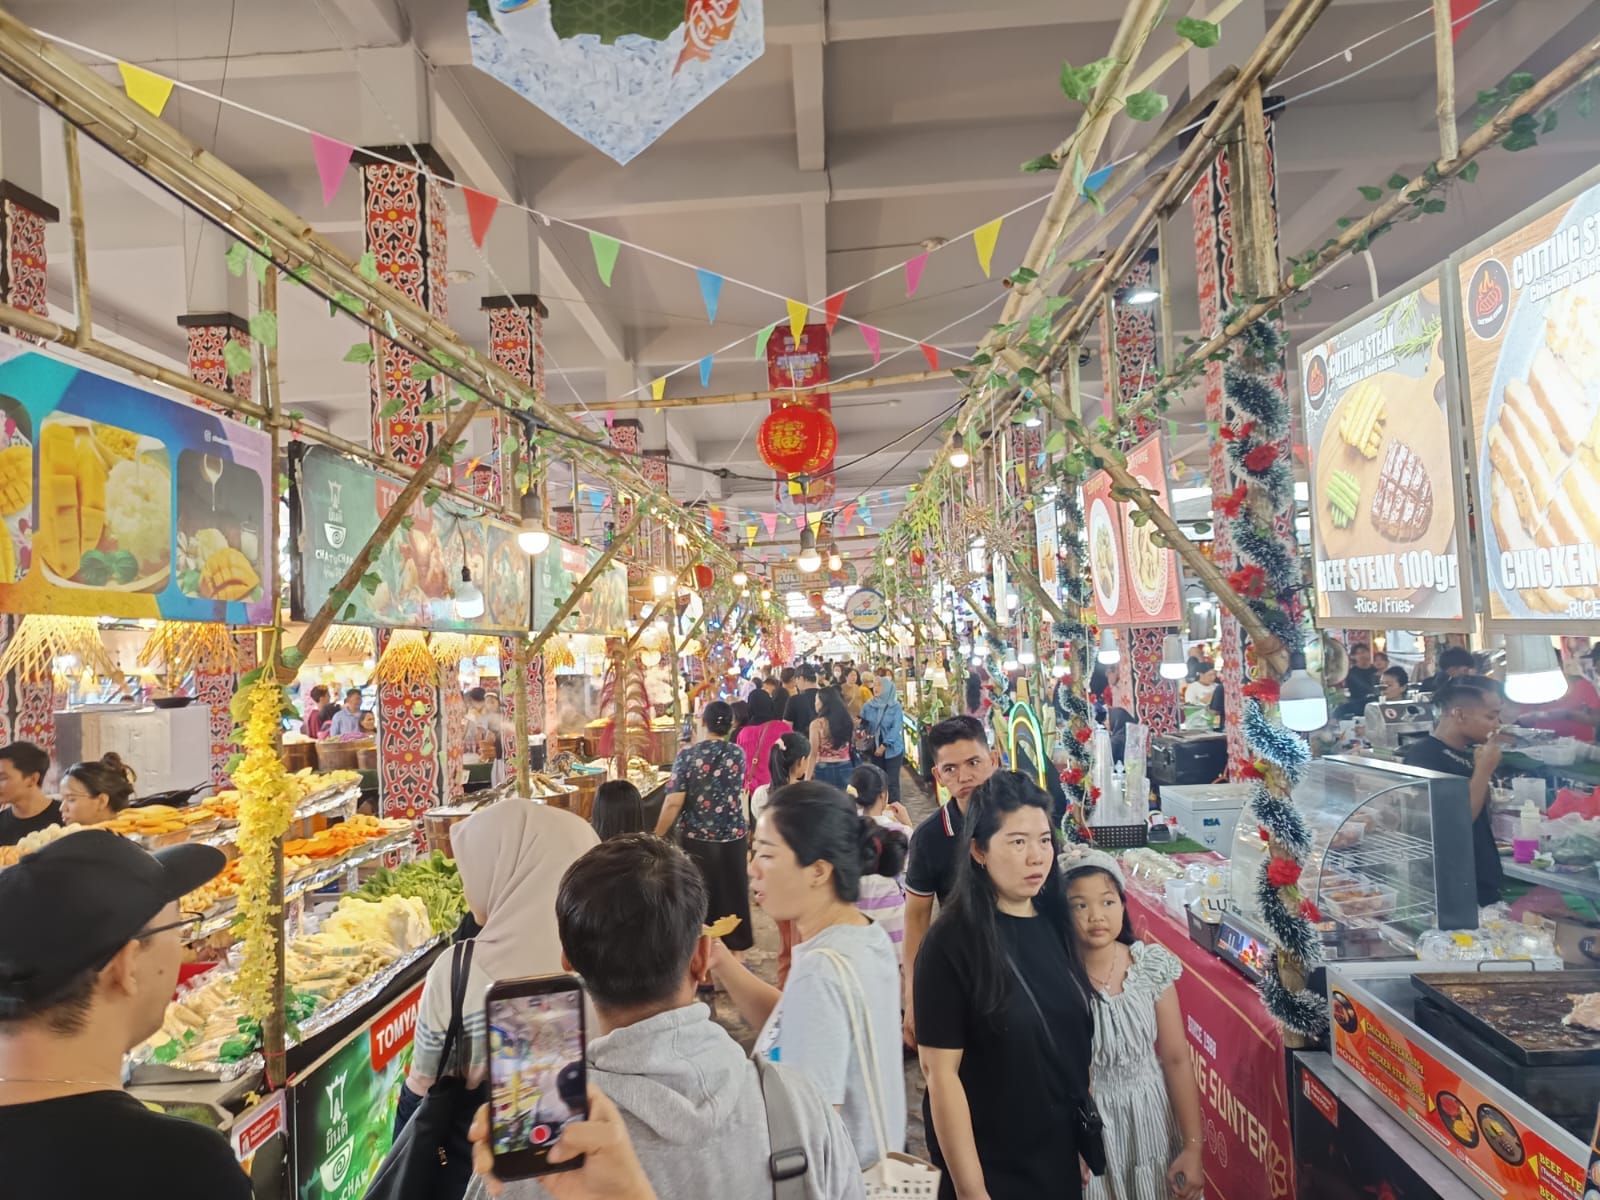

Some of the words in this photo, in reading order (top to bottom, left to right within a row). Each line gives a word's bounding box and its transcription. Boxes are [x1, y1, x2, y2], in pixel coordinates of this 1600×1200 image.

[1513, 225, 1580, 290] CUTTING
[1329, 340, 1364, 378] CUTTING
[1365, 323, 1395, 361] STEAK
[1317, 558, 1348, 593] BEEF
[1348, 552, 1399, 591] STEAK
[1400, 550, 1458, 593] 100gr
[1500, 543, 1598, 591] CHICKEN
[376, 1003, 417, 1056] TOMYA
[1187, 1040, 1206, 1096] NG
[1209, 1067, 1268, 1164] SUNTER
[1538, 1152, 1562, 1176] BEEF
[1563, 1171, 1584, 1193] STE
